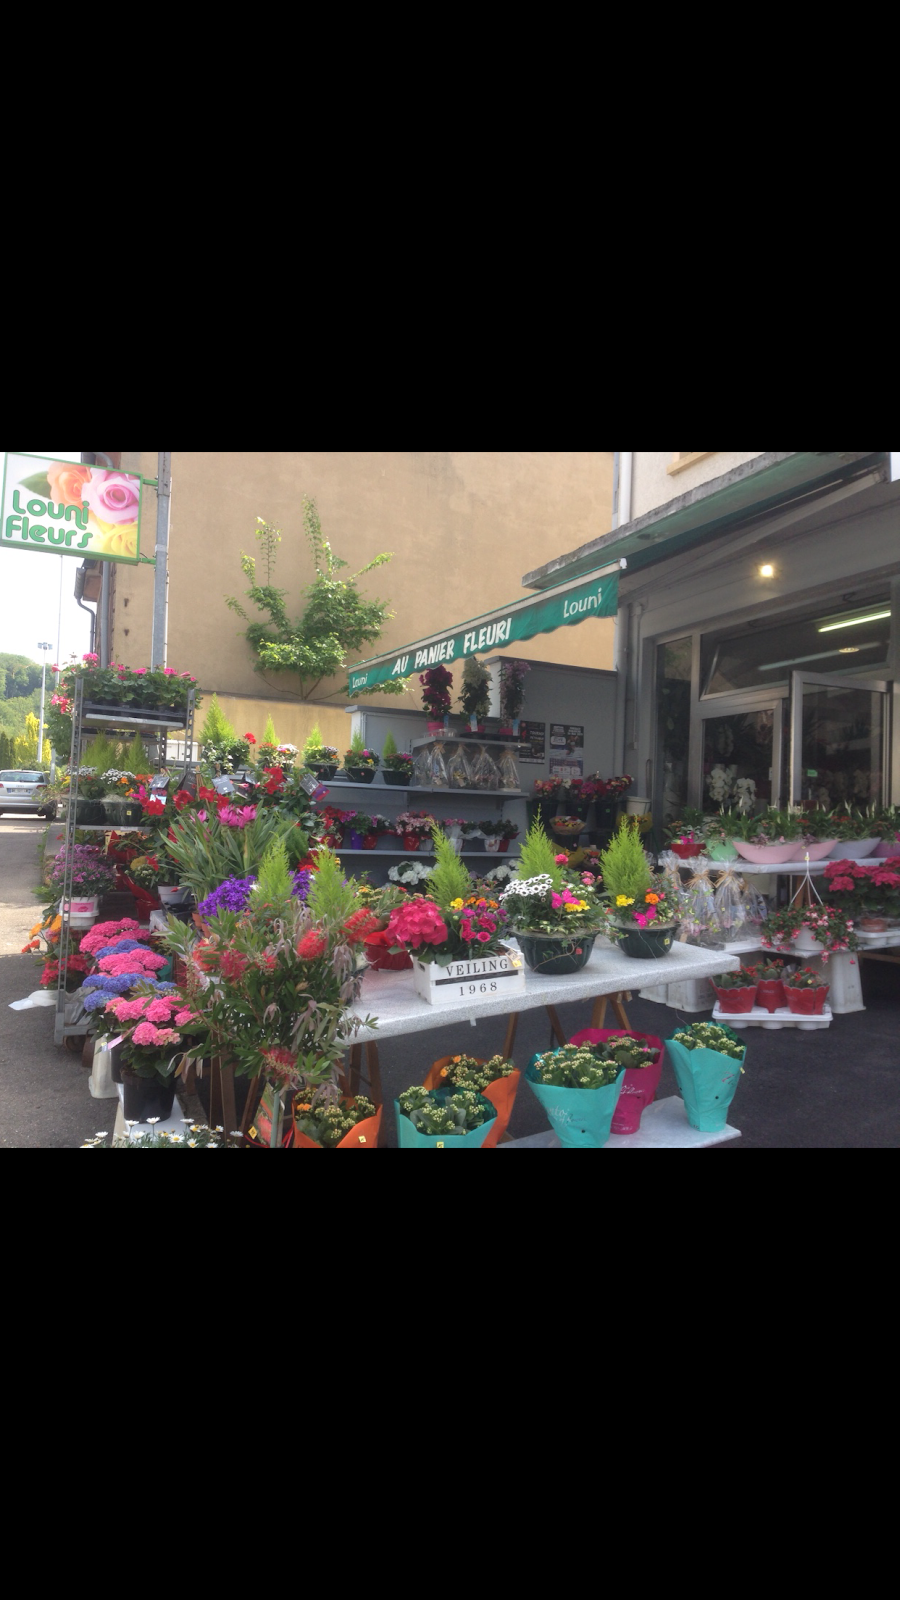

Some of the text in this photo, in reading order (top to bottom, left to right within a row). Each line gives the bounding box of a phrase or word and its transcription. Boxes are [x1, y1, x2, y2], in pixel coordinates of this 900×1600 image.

[12, 489, 90, 530] Louni
[5, 514, 94, 548] Fleurs
[563, 587, 602, 618] Louni
[391, 617, 513, 675] AU PANIER FLEURI
[352, 673, 368, 689] Louni
[446, 958, 508, 977] VEILING
[459, 981, 498, 996] 1968
